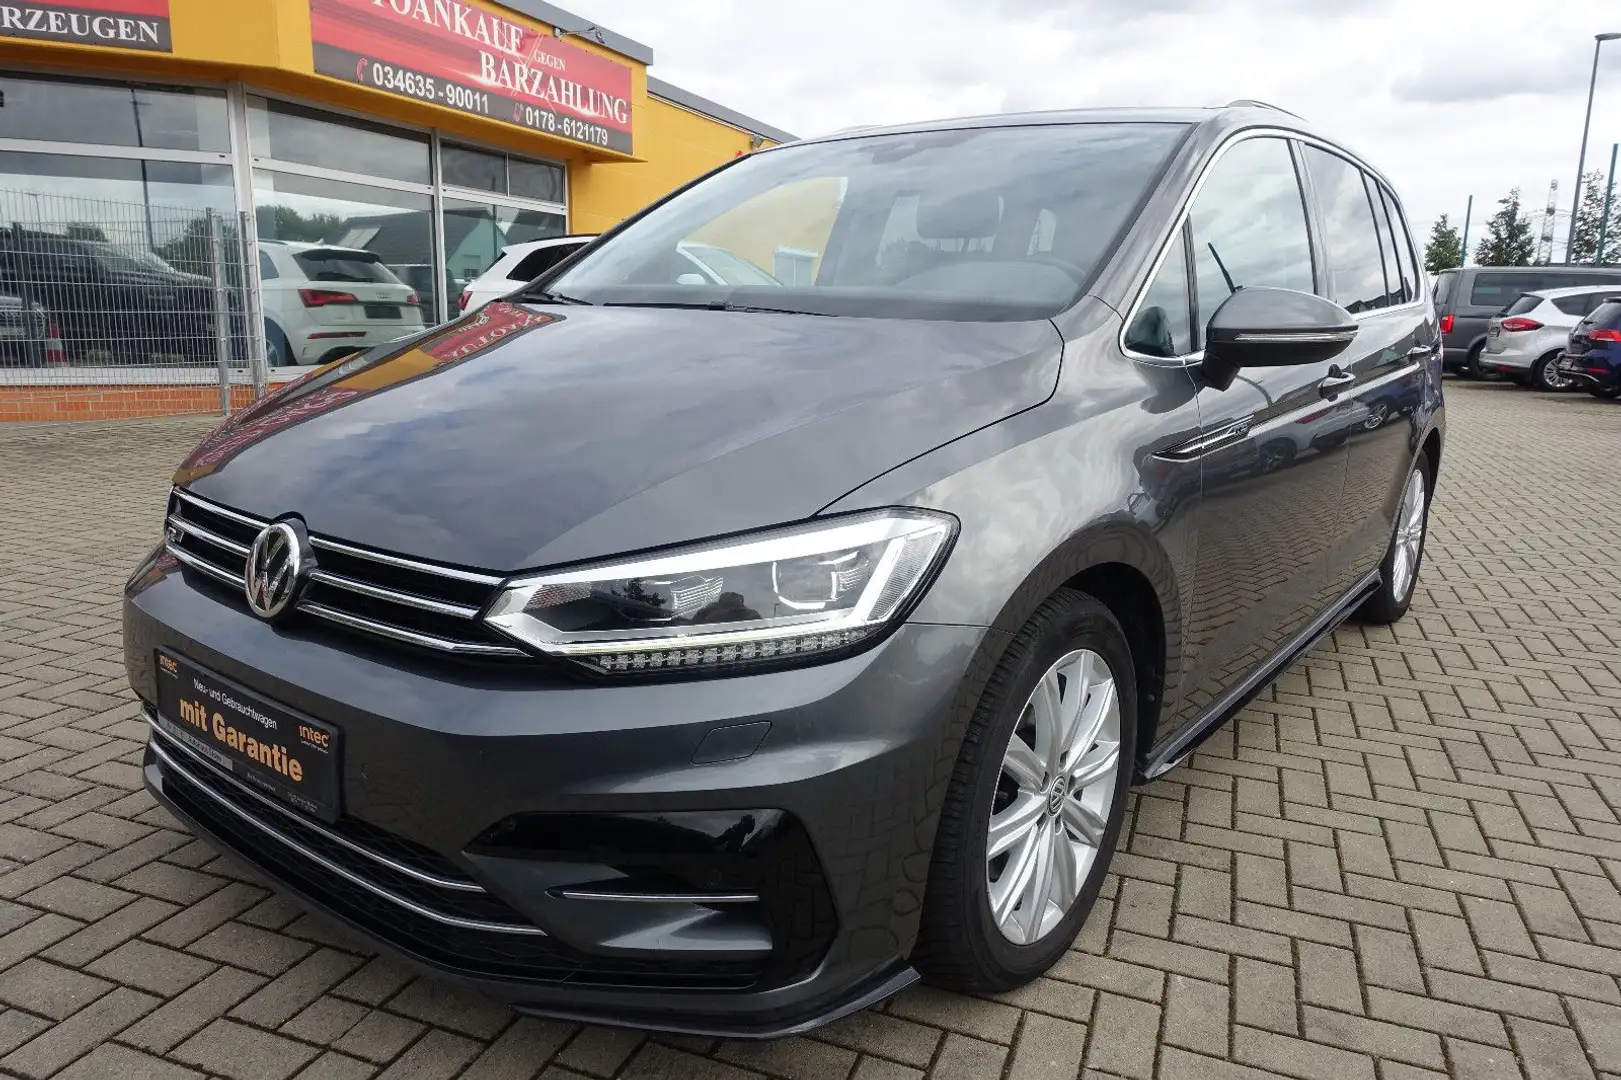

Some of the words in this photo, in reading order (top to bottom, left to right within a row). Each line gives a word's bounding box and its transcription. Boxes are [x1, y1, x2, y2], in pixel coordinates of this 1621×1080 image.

[0, 6, 160, 45] RZEUGEN
[372, 0, 524, 57] OANKAUF
[479, 50, 629, 124] BARZAHLUNG
[532, 50, 567, 71] GEGEN
[180, 698, 208, 733] mit
[212, 712, 304, 783] Garantie
